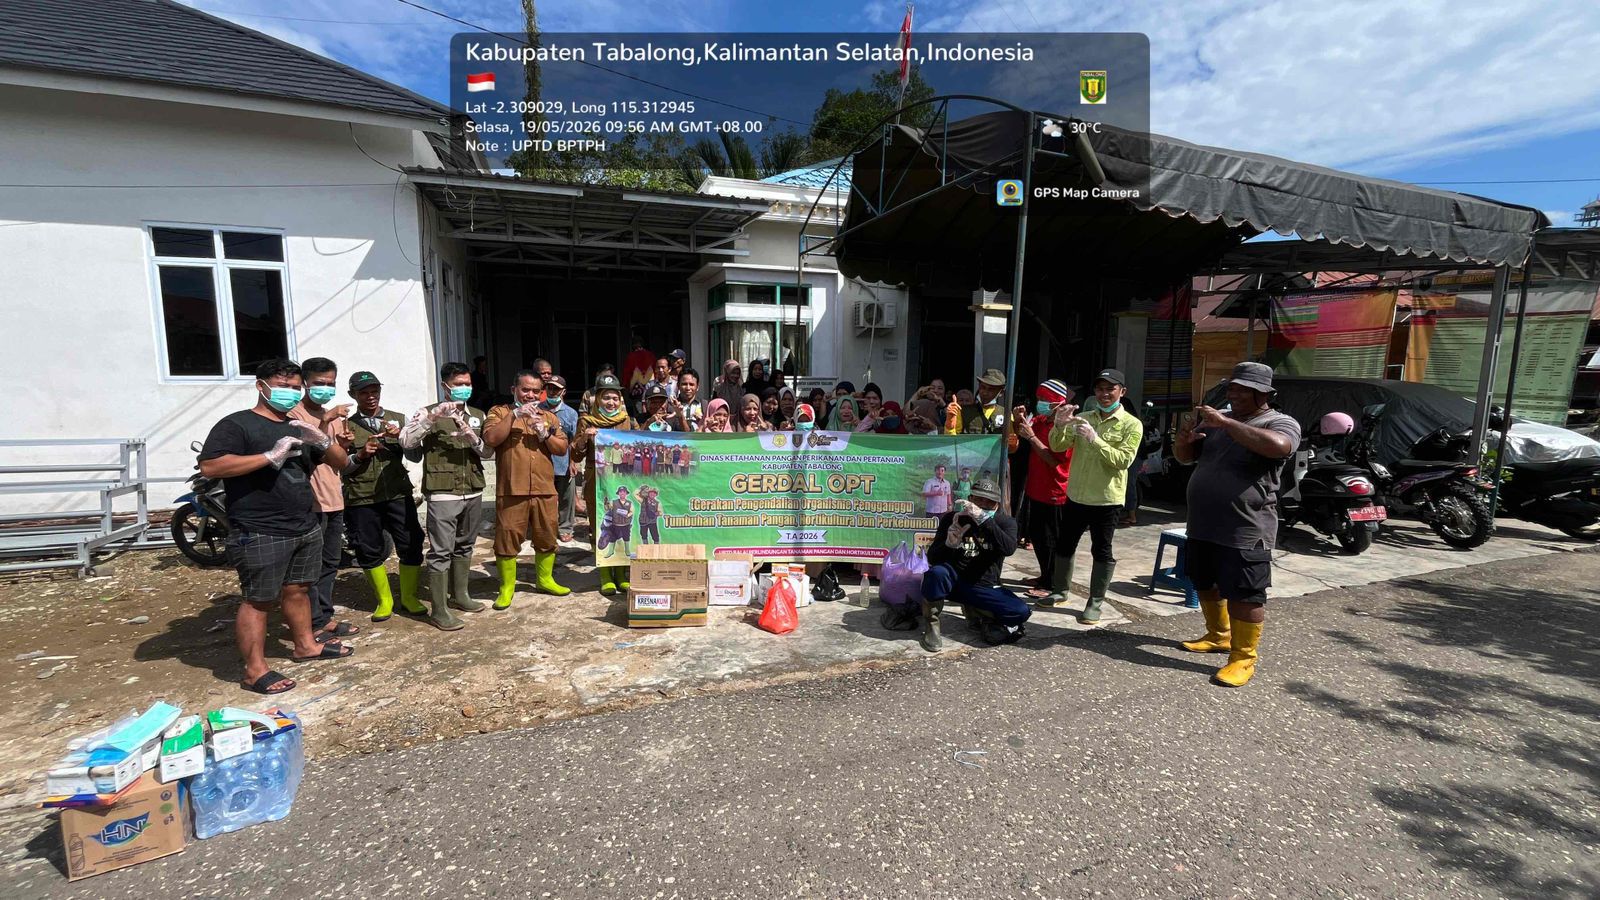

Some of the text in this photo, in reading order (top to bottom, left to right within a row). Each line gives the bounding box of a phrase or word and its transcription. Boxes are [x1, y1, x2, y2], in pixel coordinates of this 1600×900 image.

[730, 474, 876, 494] GERDAL OPT
[690, 498, 913, 513] (Gerakan Pengendalian Organisme Pengganggu
[664, 513, 938, 529] Tumbuhan Tanaman Pangan, Hortikultura Dan Perkebunan)
[799, 532, 818, 540] 2026
[637, 596, 669, 605] KRESNAKUM
